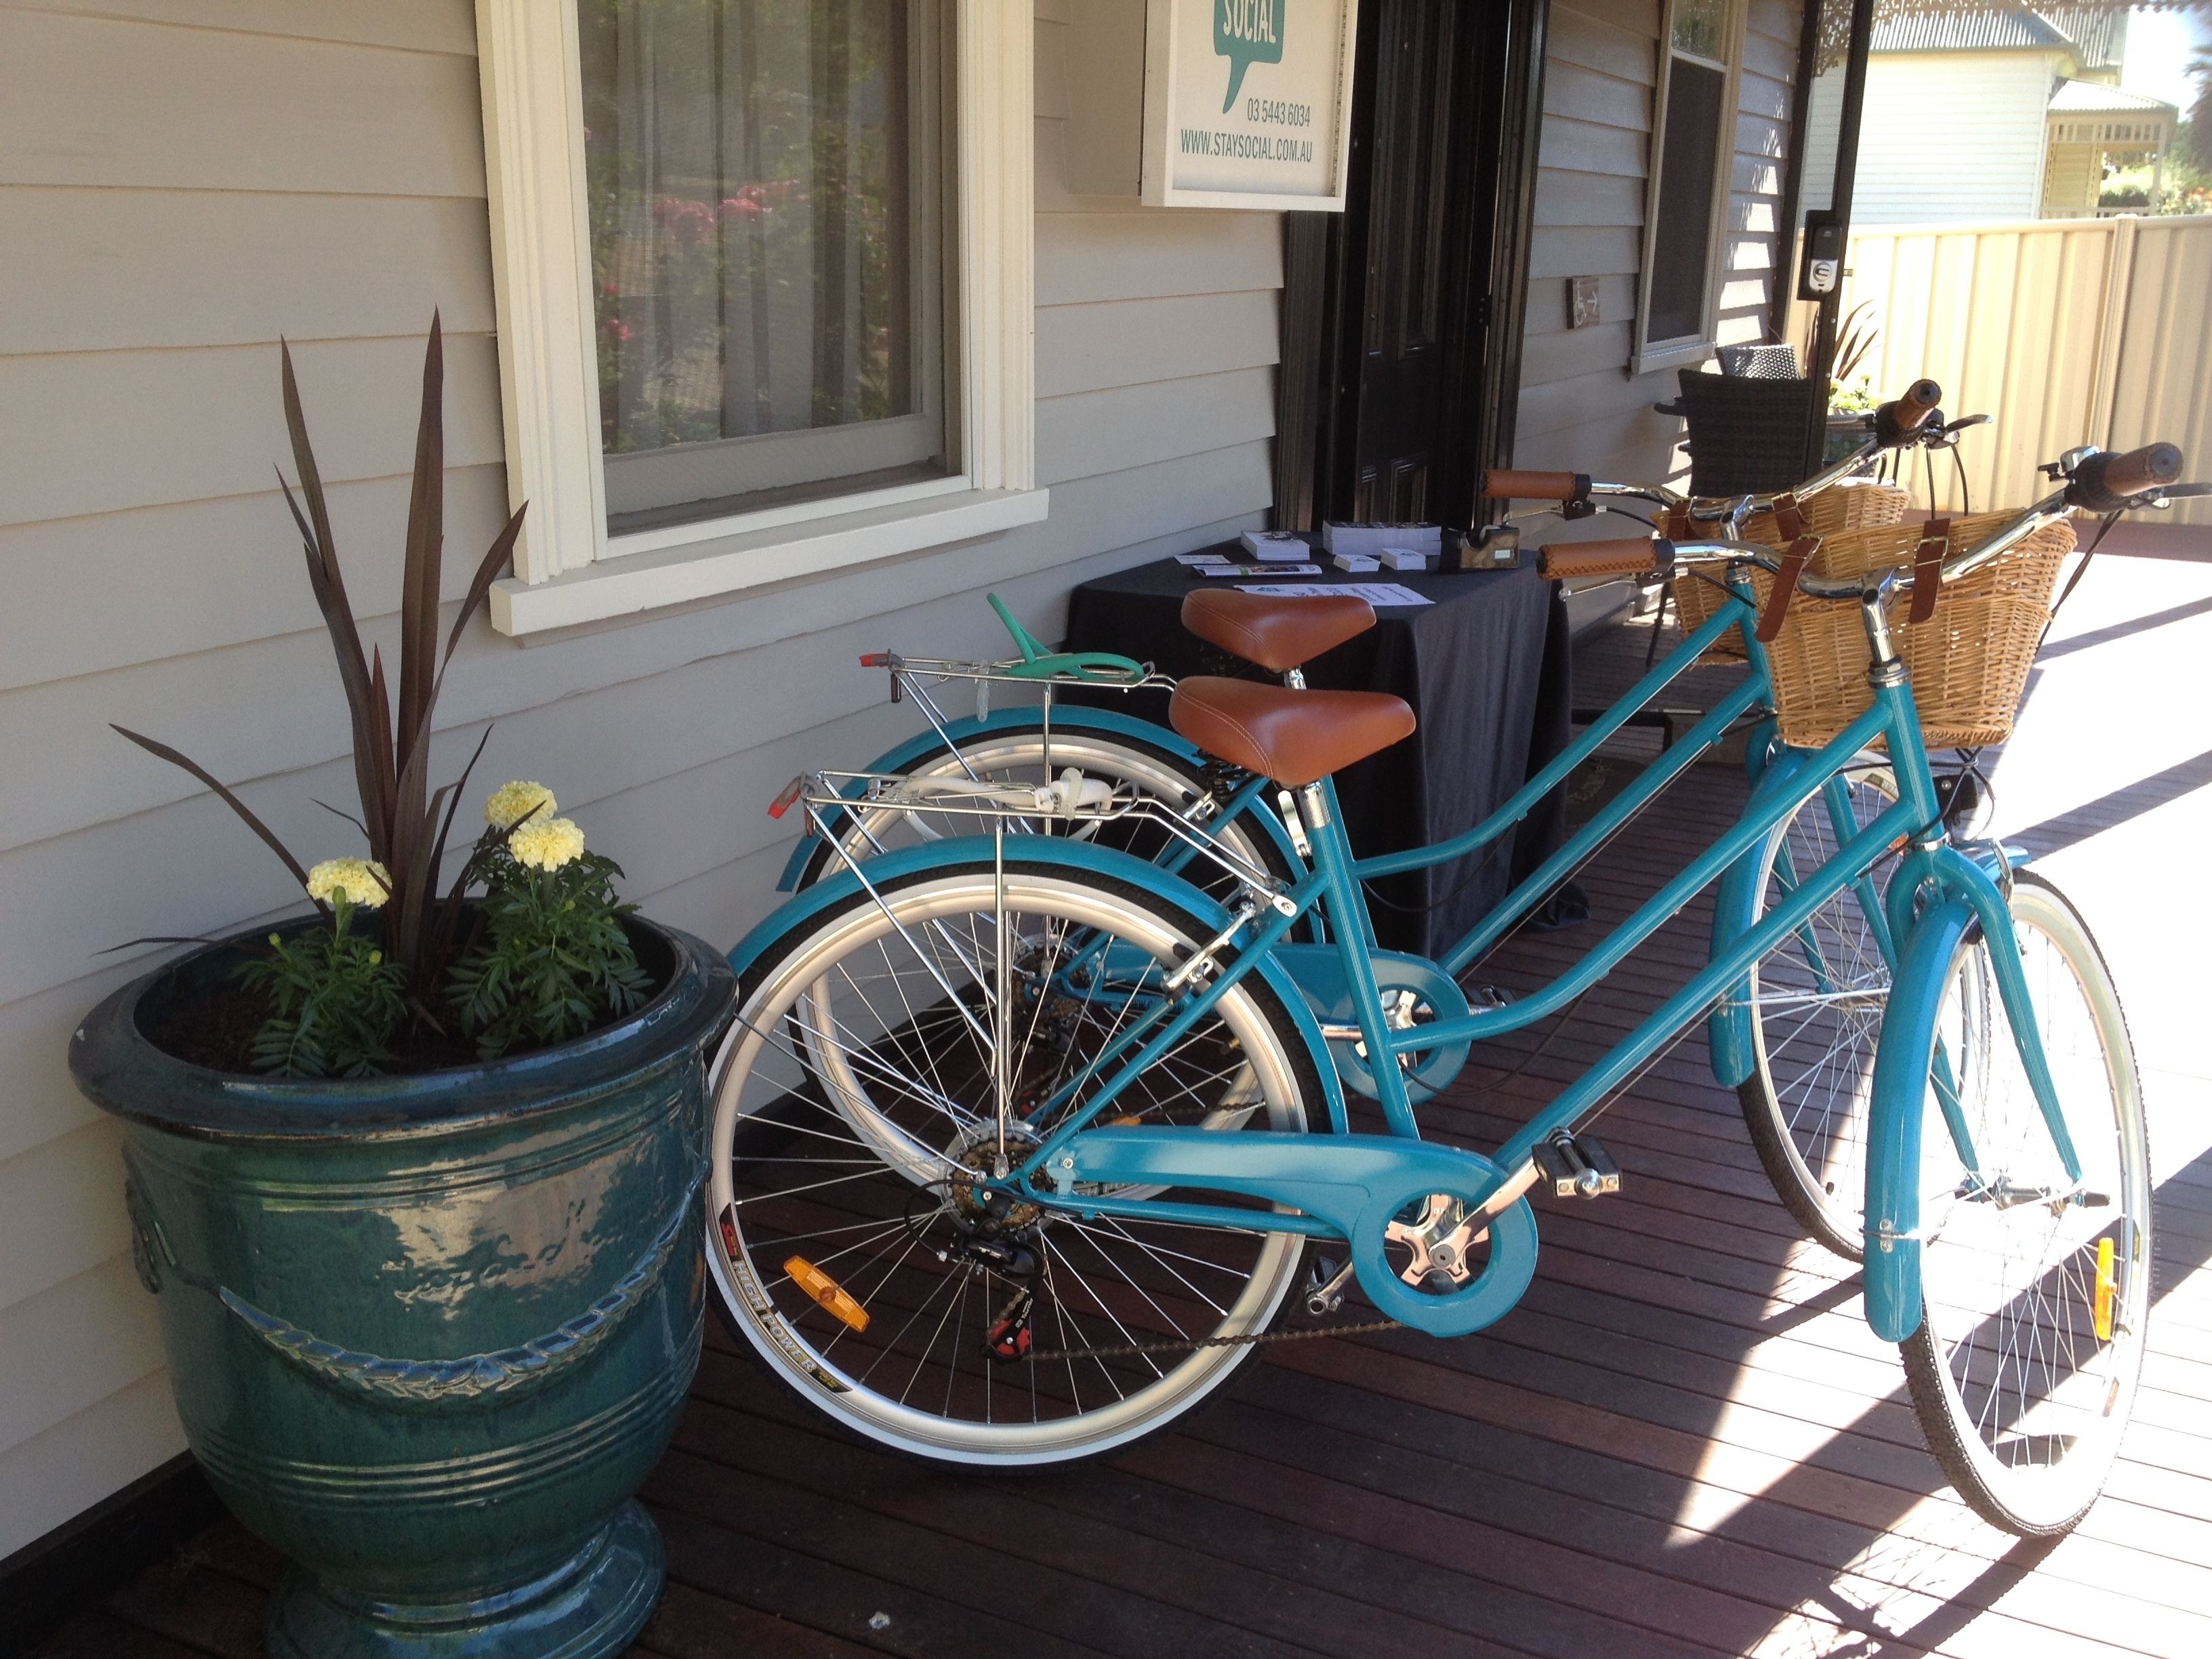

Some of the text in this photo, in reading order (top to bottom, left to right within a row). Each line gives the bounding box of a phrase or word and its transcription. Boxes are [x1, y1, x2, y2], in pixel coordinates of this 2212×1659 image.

[1223, 0, 1276, 43] SOCIAL
[1247, 98, 1310, 127] 03 5443 6034
[1181, 129, 1312, 163] WWW.STAYSOCIAL.COM.AU
[733, 1261, 817, 1372] HIGH POWER
